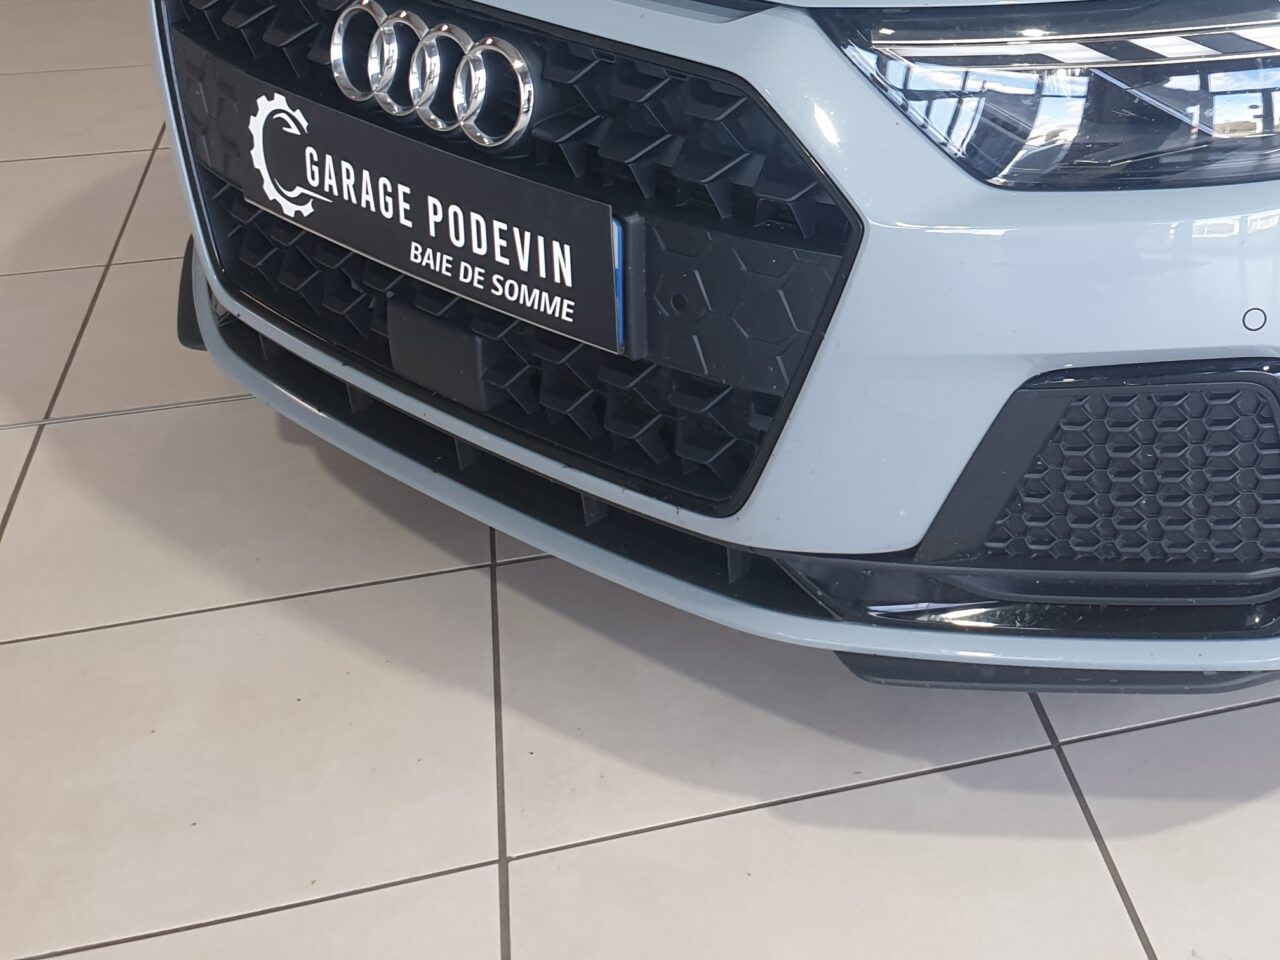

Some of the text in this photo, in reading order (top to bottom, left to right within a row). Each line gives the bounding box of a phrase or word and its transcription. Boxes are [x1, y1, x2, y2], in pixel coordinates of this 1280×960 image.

[305, 146, 573, 288] GARAGE PODEVIN
[410, 241, 575, 323] BAIE DE SOMME
